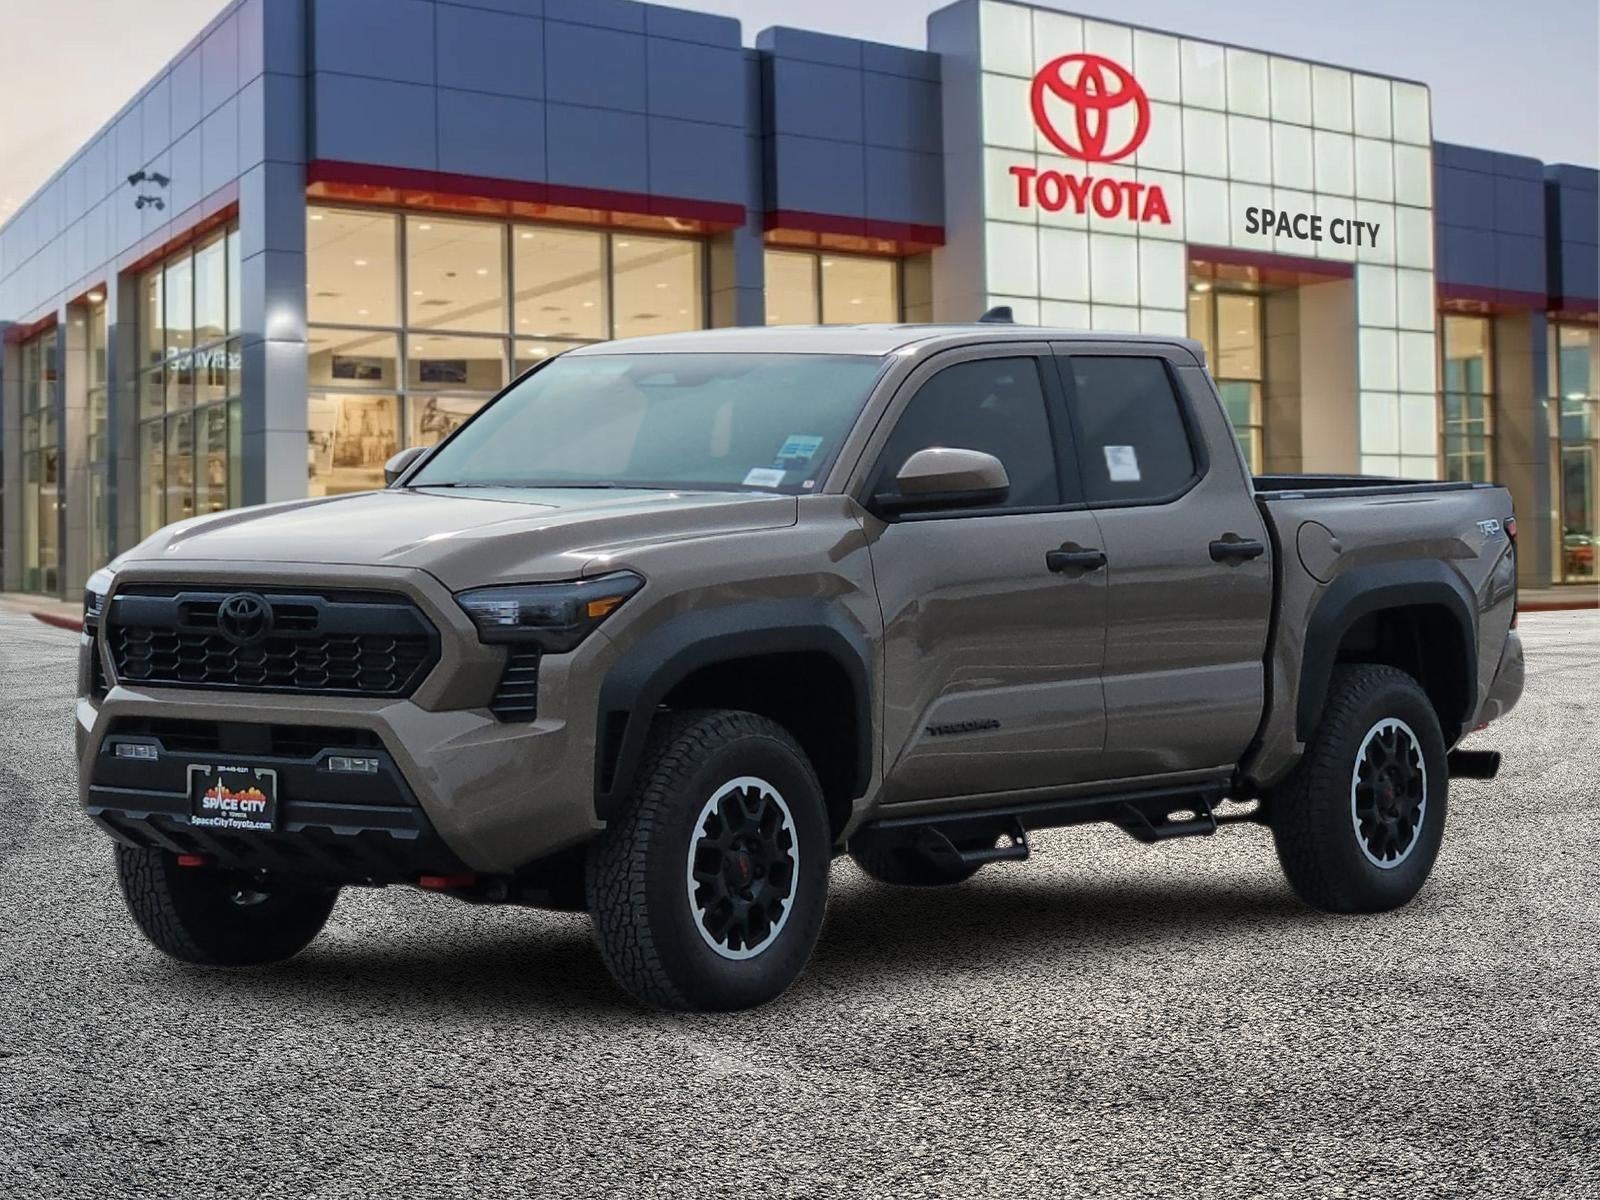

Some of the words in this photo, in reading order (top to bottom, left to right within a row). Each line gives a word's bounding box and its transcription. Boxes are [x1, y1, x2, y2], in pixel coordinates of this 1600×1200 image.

[1009, 166, 1171, 224] TOYOTA
[1245, 206, 1322, 241] SPACE
[1329, 218, 1380, 248] CITY
[1476, 519, 1500, 536] TRD
[925, 719, 1001, 736] TACOMA
[202, 797, 238, 810] SPACE
[240, 799, 266, 812] CITY
[191, 815, 272, 829] SpaceCityToyota.com
